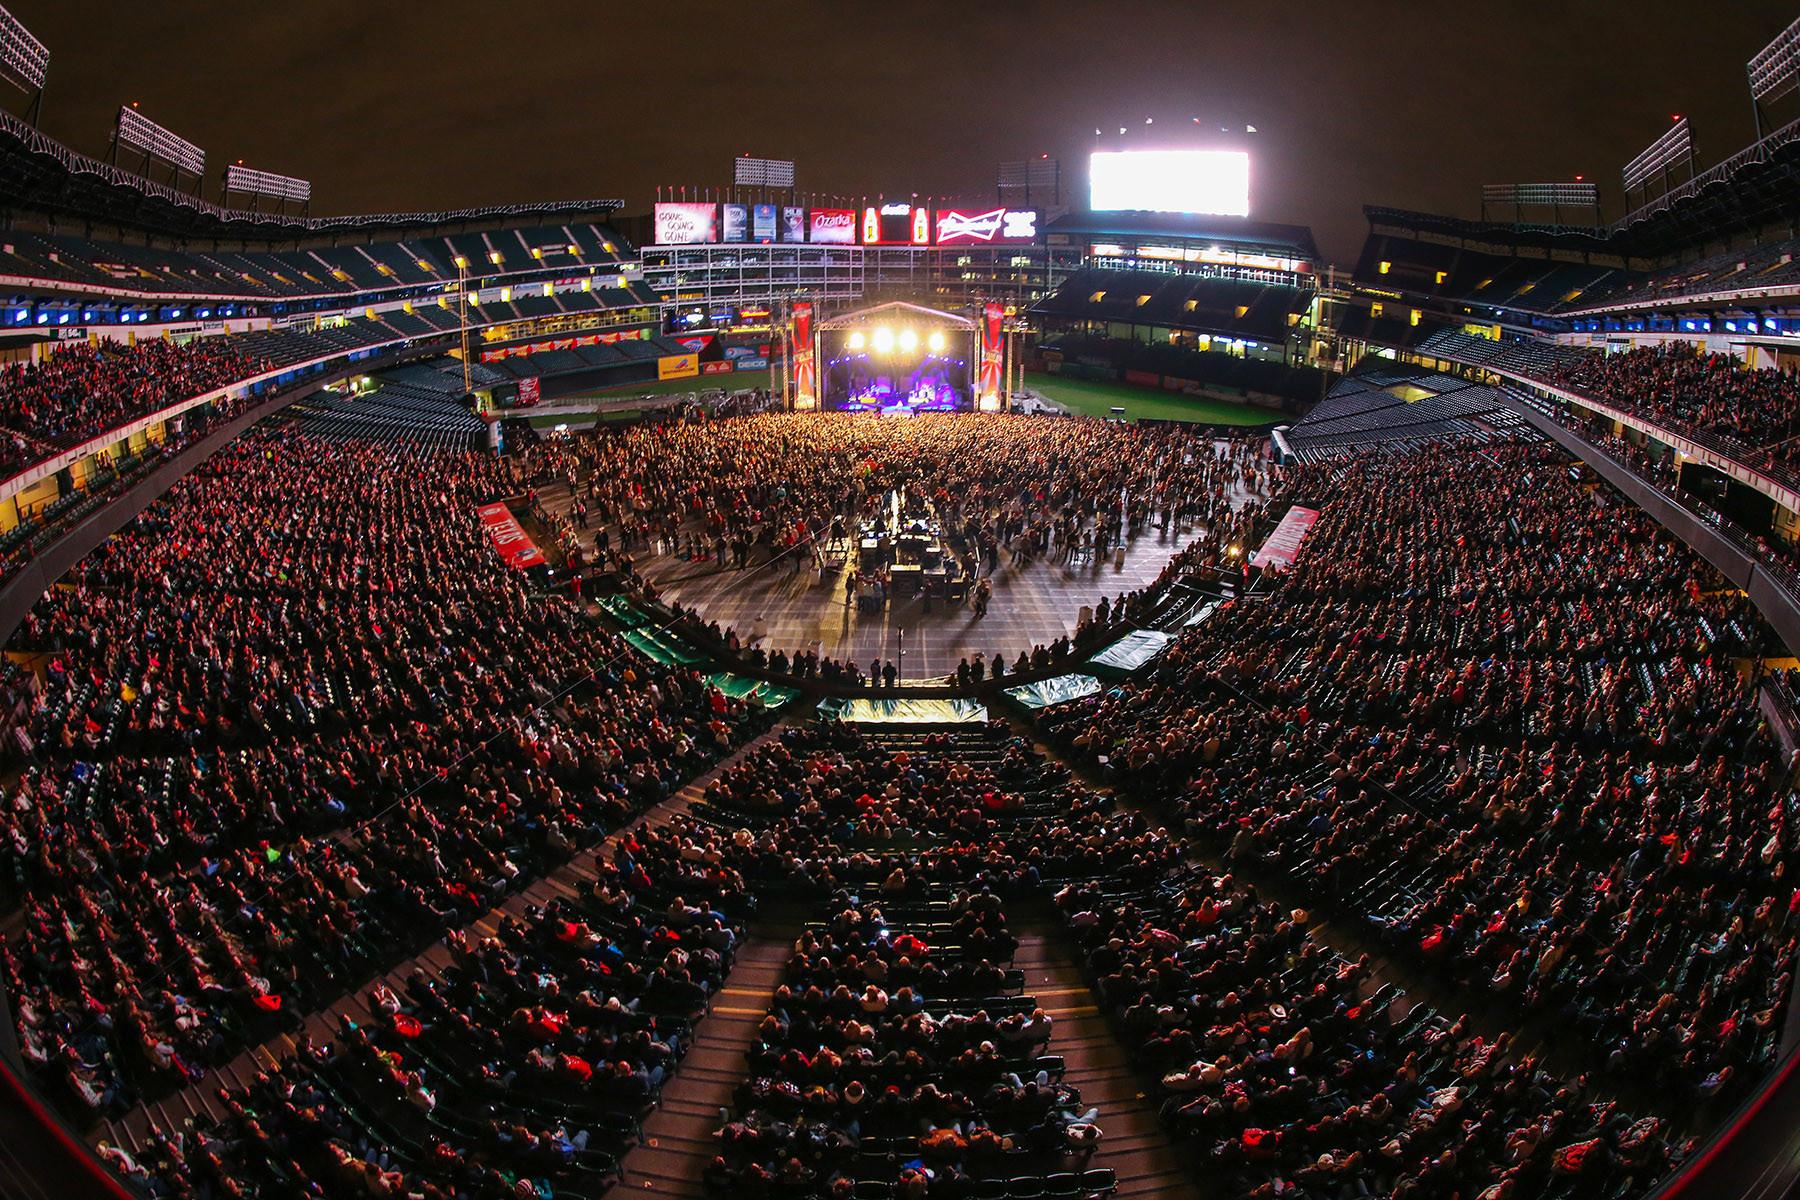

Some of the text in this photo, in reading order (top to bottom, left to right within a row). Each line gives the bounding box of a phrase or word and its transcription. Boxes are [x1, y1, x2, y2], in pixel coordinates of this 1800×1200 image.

[659, 212, 682, 221] GOING
[815, 214, 850, 228] Ozarka
[667, 221, 694, 230] GOING
[664, 231, 688, 242] GONE
[489, 519, 524, 545] TEXAS
